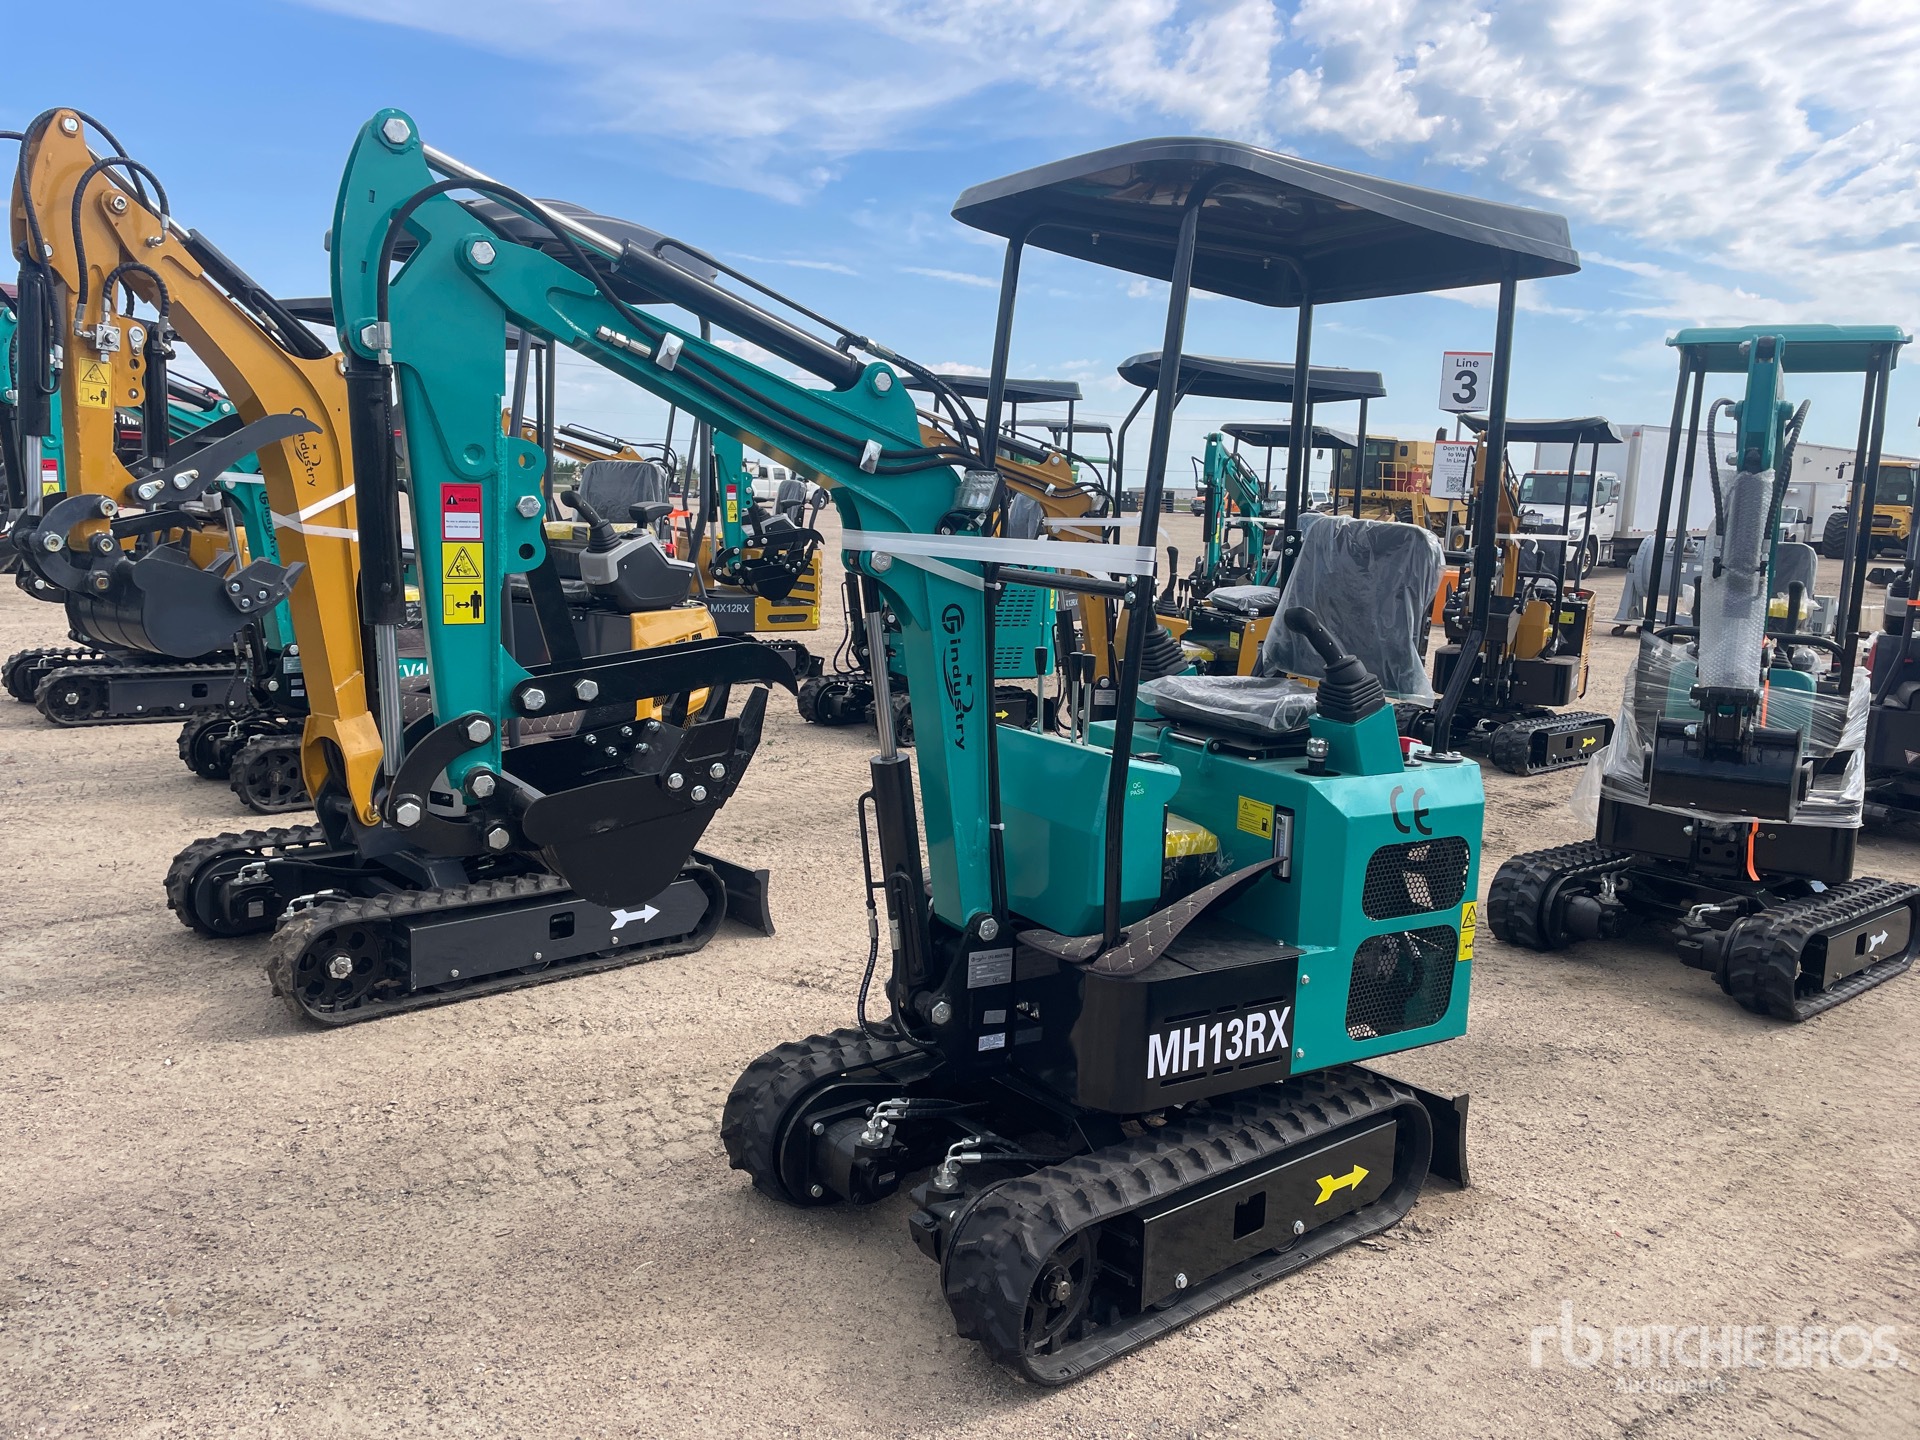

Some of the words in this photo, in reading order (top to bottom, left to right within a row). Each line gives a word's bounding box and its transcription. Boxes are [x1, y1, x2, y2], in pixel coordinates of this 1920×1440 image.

[1456, 358, 1479, 368] Line
[1452, 369, 1478, 404] 3
[710, 603, 750, 613] MX12RX
[1132, 781, 1142, 789] QC
[1130, 788, 1145, 797] PASS
[1390, 785, 1433, 836] CE
[1147, 1006, 1291, 1080] MH13RX
